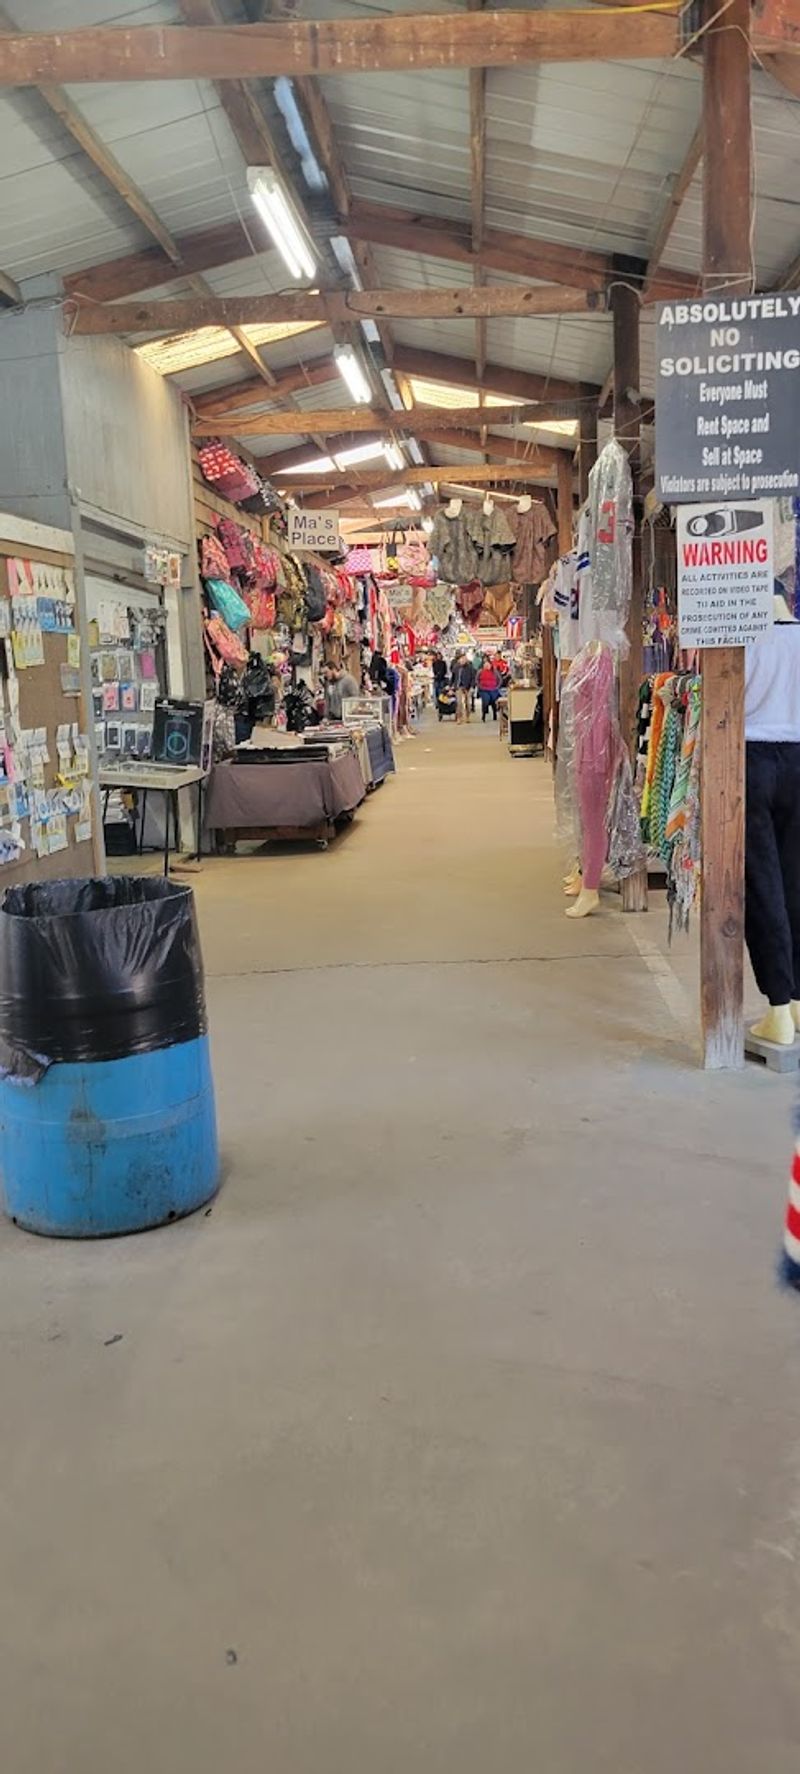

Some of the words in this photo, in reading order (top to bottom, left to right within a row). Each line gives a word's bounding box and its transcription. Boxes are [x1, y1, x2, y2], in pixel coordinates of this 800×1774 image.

[660, 297, 800, 326] ABSOLUTELY
[710, 328, 740, 347] NO
[660, 350, 800, 376] SOLICITING
[699, 382, 742, 405] Everyone
[744, 380, 768, 400] Must
[697, 416, 719, 436] Rent
[721, 415, 749, 439] Space
[751, 413, 769, 434] and
[702, 448, 719, 466] Sell
[721, 450, 732, 465] at
[733, 446, 763, 469] Space
[660, 475, 695, 493] Violators
[697, 477, 710, 492] are
[711, 474, 741, 495] subject
[742, 474, 750, 490] to
[751, 470, 798, 493] prosecution
[294, 515, 333, 529] Ma's
[291, 532, 337, 546] Place
[683, 539, 767, 567] WARNING
[682, 574, 698, 583] ALL
[700, 571, 749, 582] ACTIVITIES
[751, 570, 768, 579] ARE
[718, 586, 728, 595] ON
[730, 585, 751, 594] VIDEO
[752, 584, 769, 593] TAPE
[710, 600, 725, 608] AID
[728, 599, 737, 607] IN
[740, 598, 757, 606] THE
[682, 613, 737, 622] PROSECUTION
[739, 611, 749, 620] OF
[752, 610, 768, 619] ANY
[696, 636, 716, 646] THIS
[717, 634, 757, 645] FACILITY
